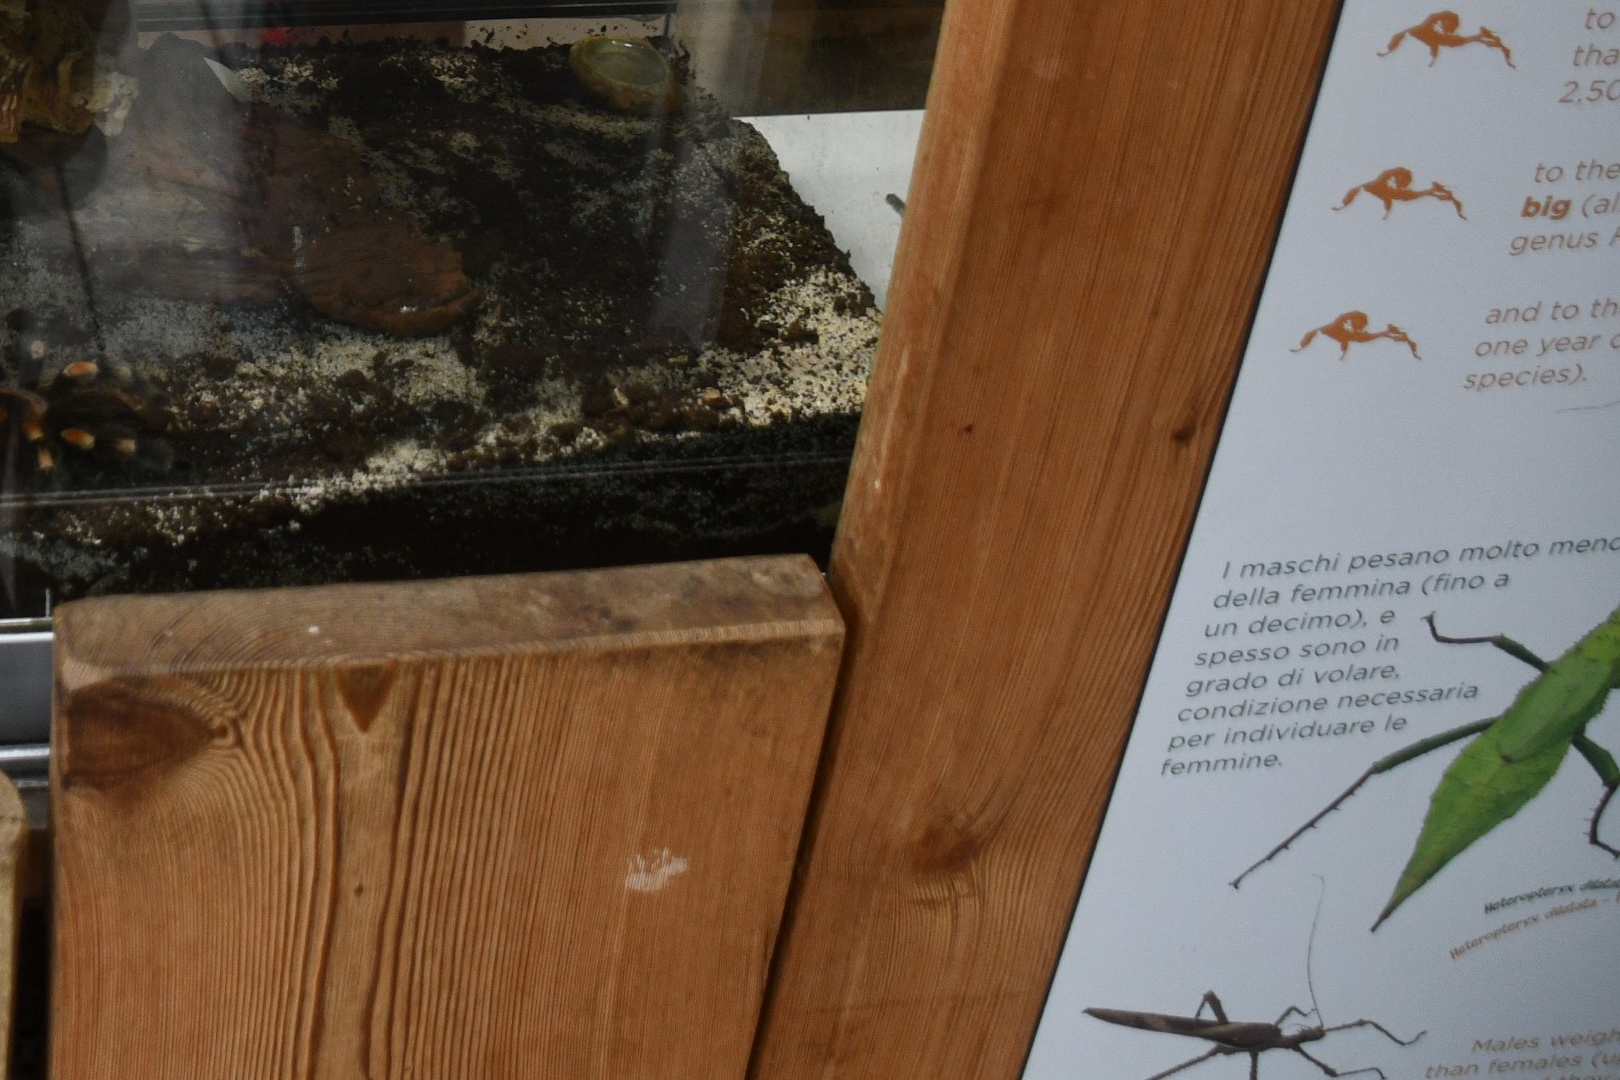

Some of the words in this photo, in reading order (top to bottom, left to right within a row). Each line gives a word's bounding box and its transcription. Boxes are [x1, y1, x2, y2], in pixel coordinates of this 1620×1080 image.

[1584, 8, 1616, 30] to
[1534, 162, 1564, 184] to
[1575, 159, 1620, 182] the
[1520, 195, 1572, 220] big
[1509, 231, 1599, 256] genus
[1485, 300, 1542, 324] and
[1550, 300, 1580, 321] to
[1475, 338, 1528, 357] one
[1535, 333, 1602, 357] year
[1463, 363, 1587, 392] species).
[1222, 560, 1231, 579] I
[1240, 552, 1341, 578] maschi
[1347, 548, 1450, 574] pesano
[1458, 539, 1540, 562] molto
[1212, 586, 1281, 609] della
[1290, 578, 1411, 603] femmina
[1421, 573, 1485, 596] (fino
[1493, 572, 1510, 588] a
[1203, 621, 1238, 638] un
[1247, 608, 1368, 634] decimo),
[1379, 609, 1395, 624] e
[1194, 644, 1290, 669] spesso
[1298, 639, 1366, 658] sono
[1375, 633, 1400, 652] in
[1185, 671, 1268, 698] grado
[1277, 667, 1305, 687] di
[1314, 663, 1400, 684] volare,
[1177, 697, 1328, 722] condizione
[1336, 682, 1479, 710] necessaria
[1167, 732, 1216, 753] per
[1223, 719, 1376, 745] individuare
[1384, 713, 1407, 732] le
[1160, 752, 1283, 777] femmine.
[1471, 1036, 1541, 1053] Males
[1425, 1062, 1479, 1080] than
[1487, 1052, 1584, 1073] females
